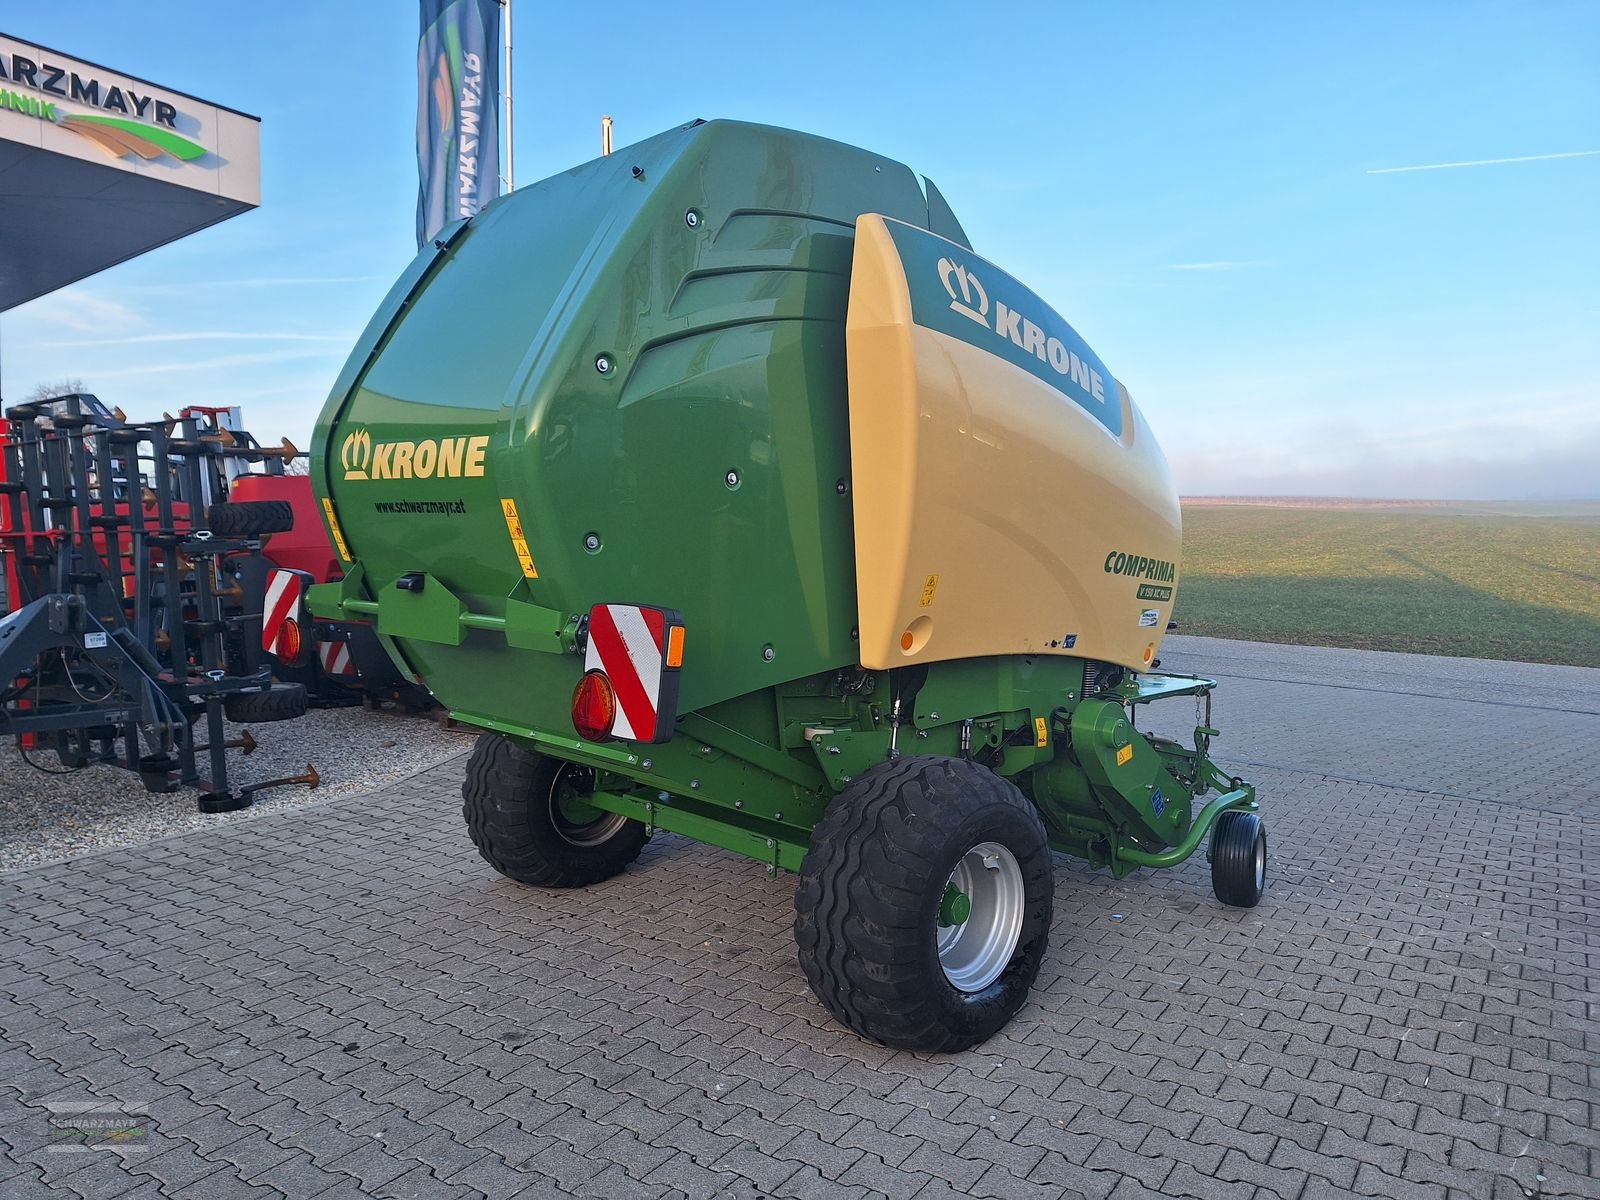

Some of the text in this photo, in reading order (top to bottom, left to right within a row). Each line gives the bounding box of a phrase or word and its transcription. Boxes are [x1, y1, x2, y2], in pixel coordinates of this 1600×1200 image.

[995, 300, 1105, 404] KRONE
[371, 435, 490, 480] KRONE
[374, 499, 466, 517] www.schwarzmayr.at
[1104, 550, 1175, 583] COMPRIMA
[1144, 587, 1154, 598] 150
[1159, 589, 1171, 599] PLUS
